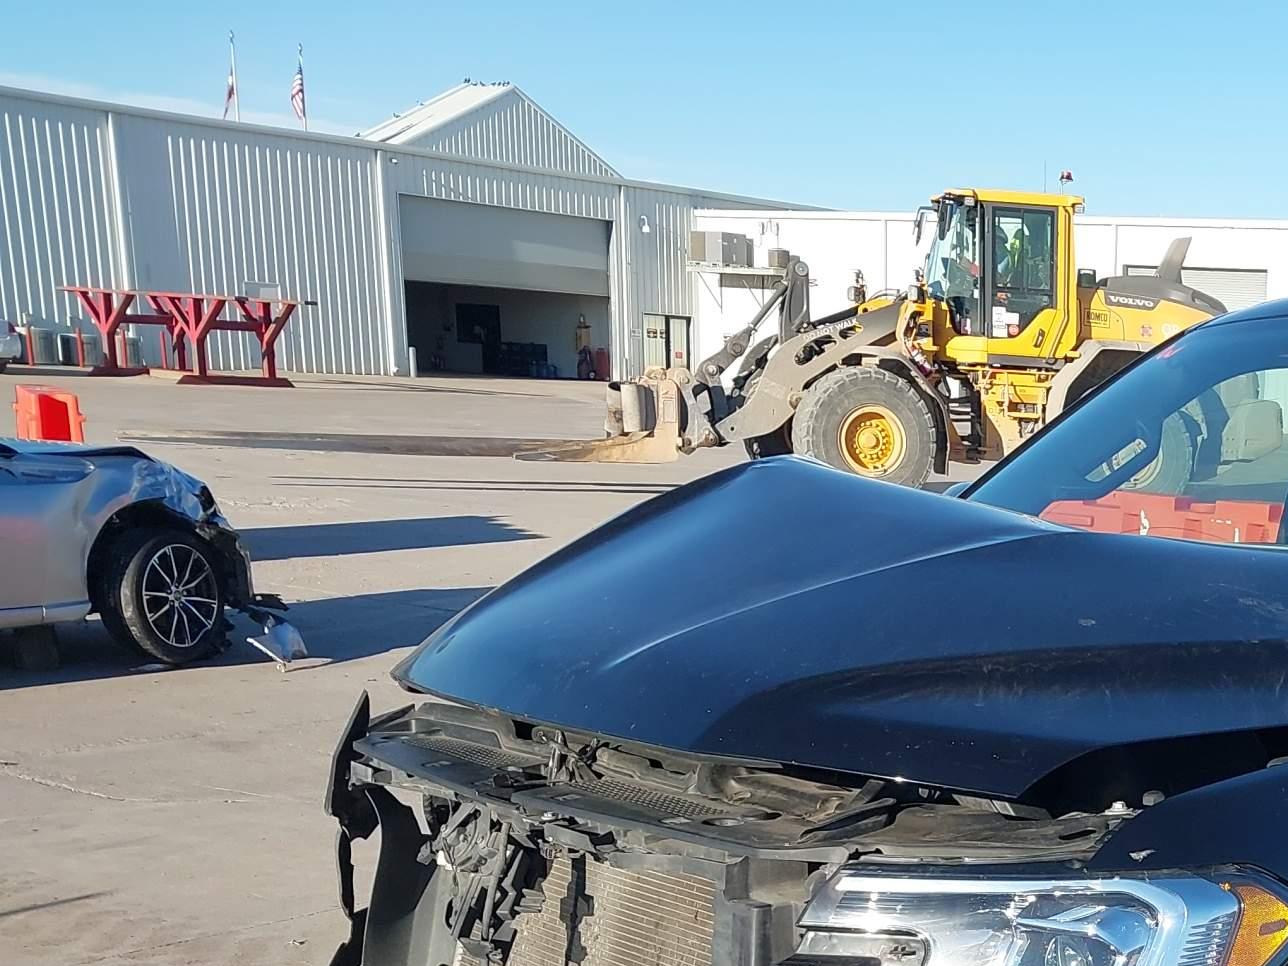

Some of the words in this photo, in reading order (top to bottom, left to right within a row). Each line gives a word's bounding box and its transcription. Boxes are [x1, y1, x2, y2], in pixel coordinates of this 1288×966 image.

[1108, 295, 1154, 307] VOLVO
[803, 332, 816, 340] DO
[817, 325, 835, 336] NOT
[834, 317, 859, 330] WALK
